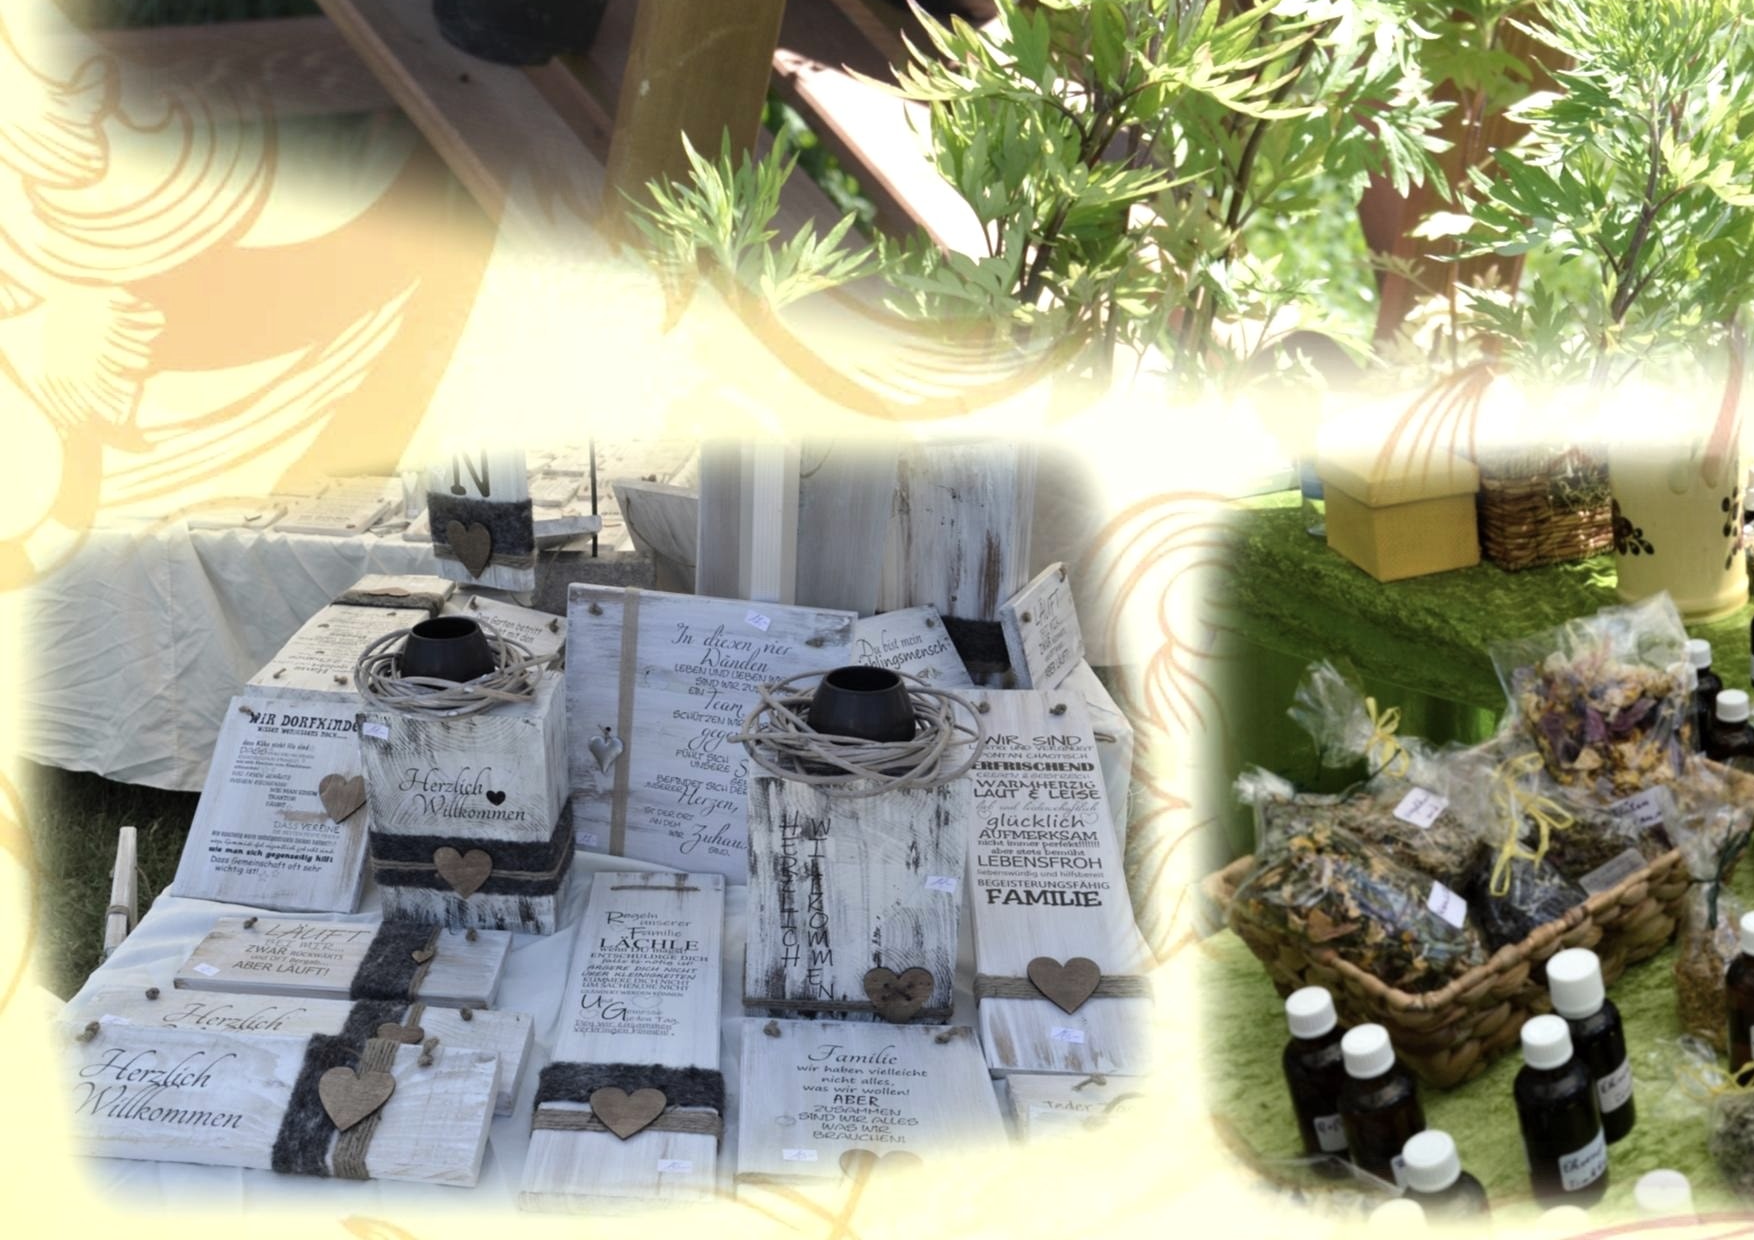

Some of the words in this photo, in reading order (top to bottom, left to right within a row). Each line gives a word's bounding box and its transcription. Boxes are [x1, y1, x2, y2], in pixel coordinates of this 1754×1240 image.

[671, 623, 694, 646] In
[901, 633, 923, 647] mein
[700, 647, 768, 673] Wänden
[674, 663, 706, 676] LEBEN
[708, 667, 730, 677] UND
[731, 671, 767, 682] LIEBEN
[695, 676, 719, 688] SIND
[721, 680, 741, 691] WIR
[688, 686, 705, 696] EIN
[673, 710, 726, 725] SCHÜTZEN
[1032, 734, 1082, 747] SIND
[706, 753, 730, 764] SICH
[1026, 752, 1089, 760] CHAOTISCH
[690, 760, 730, 773] UNSERE
[970, 761, 1096, 772] ERFRISCHEND
[399, 766, 492, 796] Herzlich
[976, 779, 1097, 790] WARMHERZIG
[973, 788, 1020, 799] LAUT
[1048, 789, 1102, 800] LEISE
[411, 793, 525, 821] Willkommen
[273, 820, 299, 830] DASS
[301, 823, 340, 834] VEREINE
[986, 813, 1085, 831] glücklich
[978, 828, 1099, 841] AUFMERKSAM
[978, 839, 1005, 847] nicht
[265, 852, 313, 862] gegenseitig
[991, 847, 1015, 855] aber
[1016, 848, 1042, 856] stets
[1044, 848, 1086, 856] bemüht
[211, 855, 229, 863] Dass
[231, 856, 286, 869] Gemeinschaft
[303, 864, 322, 872] sehr
[977, 854, 1103, 870] LEBENSFROH
[215, 865, 244, 875] wichtig
[977, 878, 1111, 890] BEGEISTERUNGSFÄHIG
[985, 888, 1104, 908] FAMILIE
[605, 911, 658, 925] Regeln
[265, 923, 371, 942] LÄUFT
[627, 926, 682, 940] Familie
[245, 944, 287, 955] ZWAR
[600, 936, 699, 952] LÄCHLE
[590, 953, 678, 961] ENTSCHULDIGE
[232, 960, 273, 971] ABER
[664, 966, 698, 974] NICHT
[614, 971, 697, 980] KLEINIGKEITEN
[163, 1002, 306, 1031] Herzlich
[808, 1044, 898, 1065] Familie
[78, 1048, 237, 1088] Herzlich
[824, 1065, 864, 1075] haben
[868, 1068, 928, 1078] vielleicht
[821, 1076, 856, 1085] nicht
[834, 1086, 858, 1094] wir
[862, 1087, 911, 1096] wollen!
[72, 1081, 243, 1129] Willkommen
[833, 1094, 880, 1107] ABER
[813, 1105, 902, 1117] ZUSAMMEN
[798, 1112, 836, 1121] SIND
[839, 1114, 867, 1124] WIR
[871, 1116, 920, 1127] ALLES
[822, 1123, 858, 1133] WAS
[861, 1125, 892, 1135] WIR
